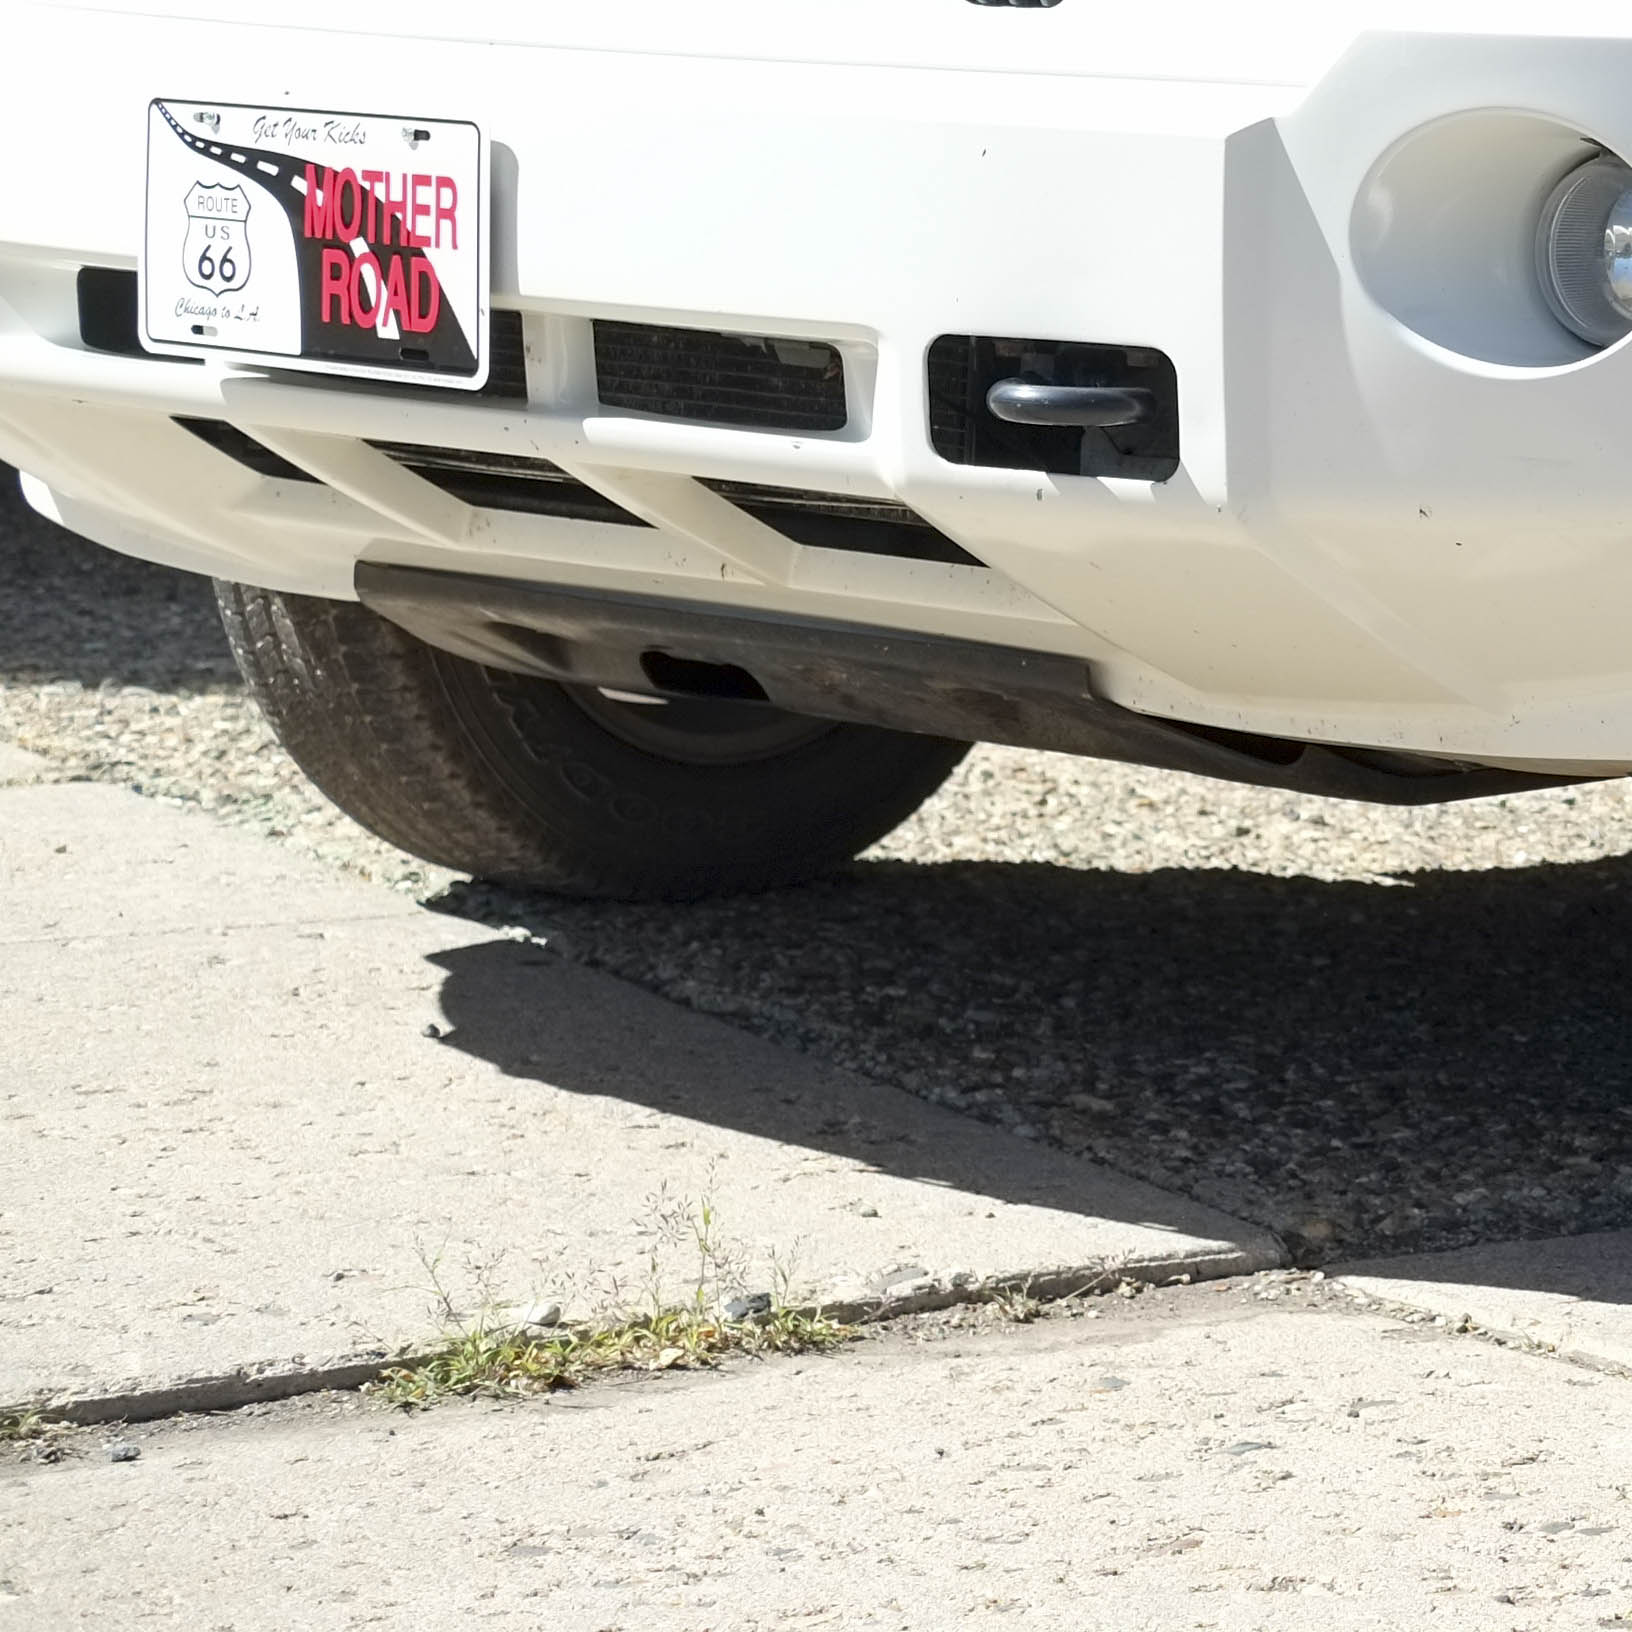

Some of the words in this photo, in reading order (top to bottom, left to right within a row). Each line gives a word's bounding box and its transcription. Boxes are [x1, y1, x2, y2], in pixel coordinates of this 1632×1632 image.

[282, 117, 318, 147] Your
[320, 120, 368, 146] Kicks
[197, 194, 239, 215] ROUTE
[303, 163, 459, 250] MOTHER
[204, 223, 231, 241] US
[198, 244, 236, 283] 66
[321, 248, 441, 333] ROAD
[174, 297, 217, 321] Chicago
